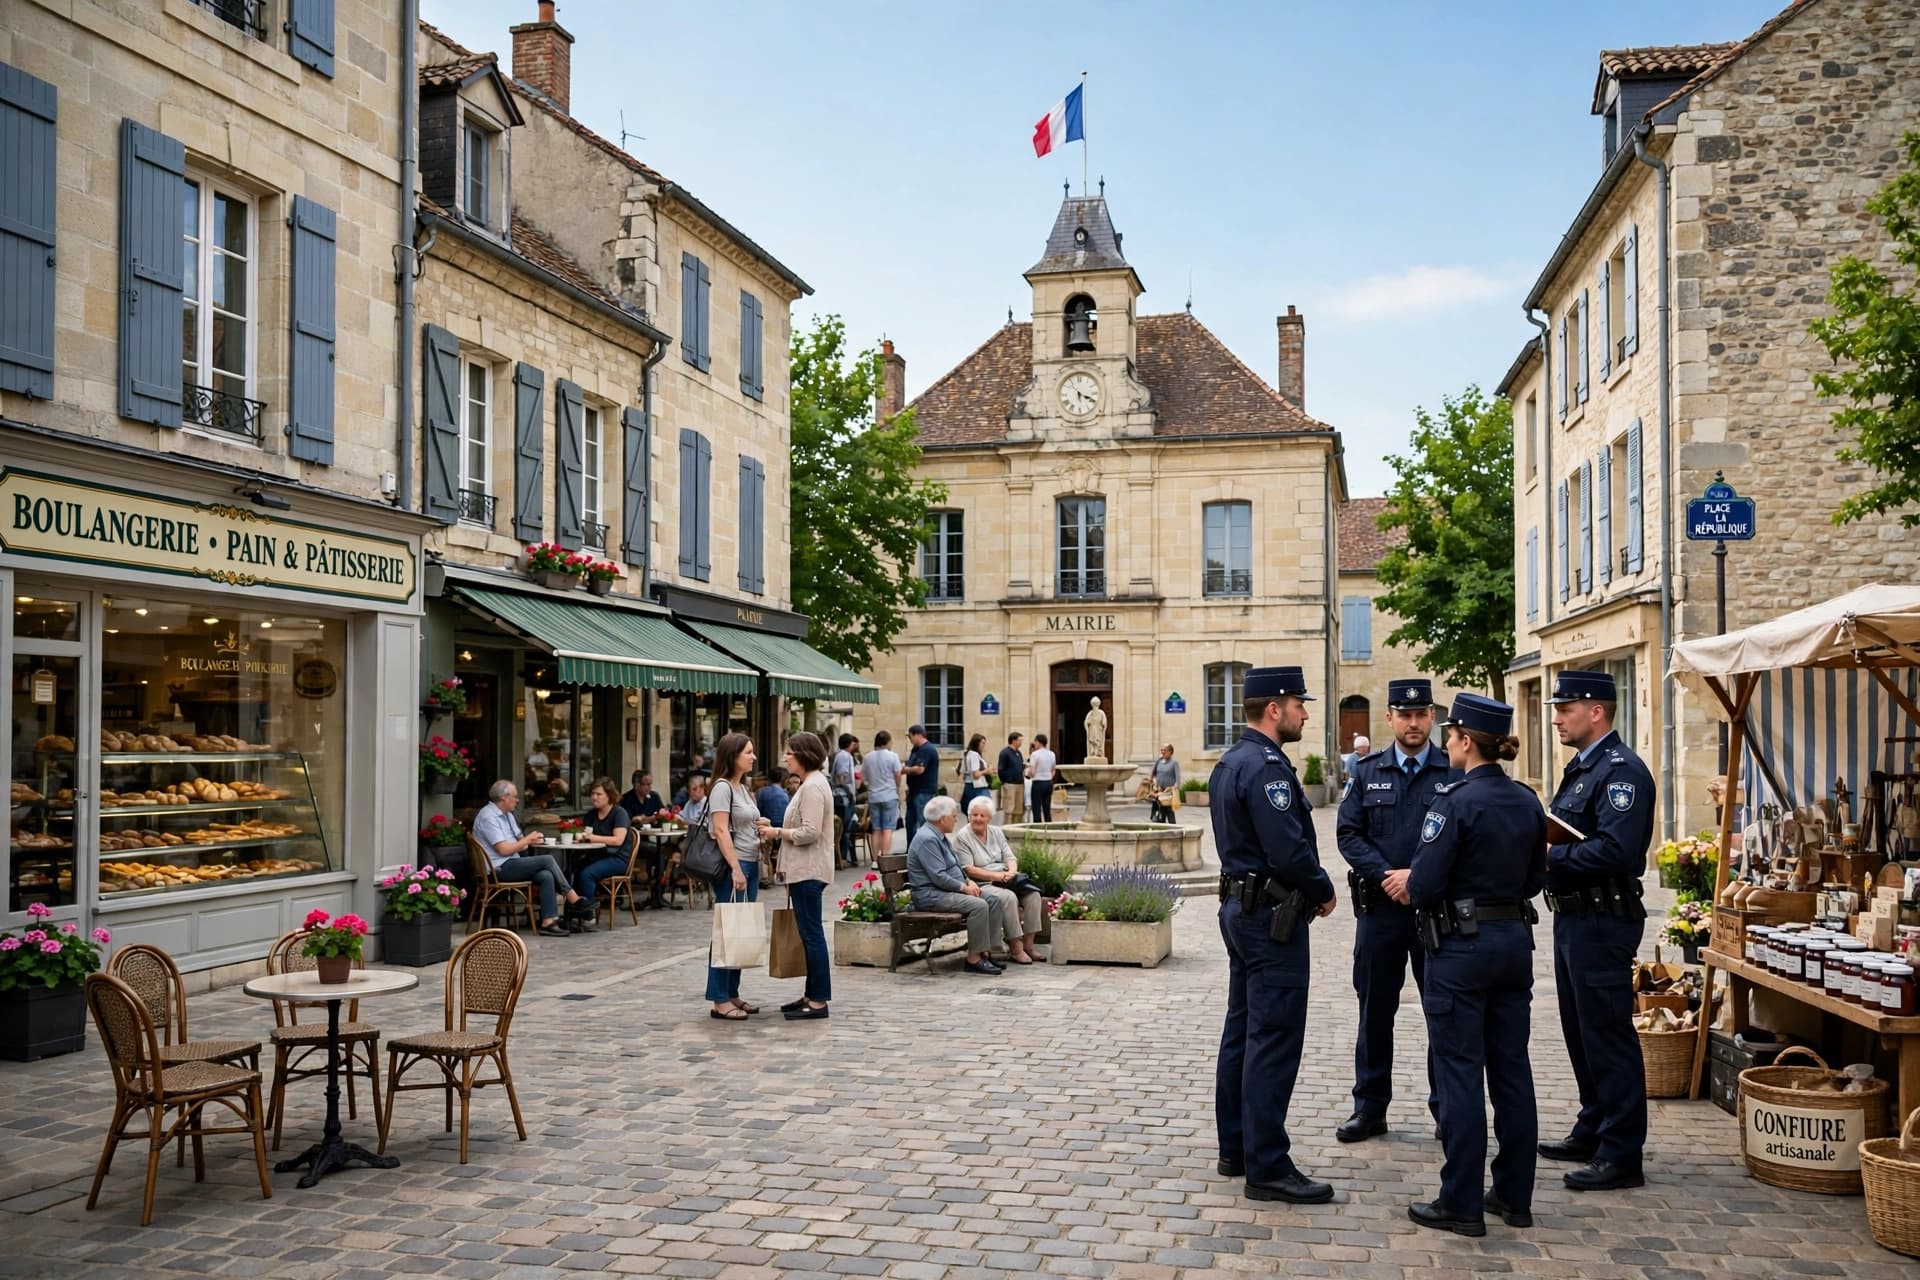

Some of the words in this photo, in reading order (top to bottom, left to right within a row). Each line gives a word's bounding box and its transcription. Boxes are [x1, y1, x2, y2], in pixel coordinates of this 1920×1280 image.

[1704, 503, 1731, 513] PLACE
[1715, 513, 1727, 523] LA
[1695, 521, 1748, 536] RÉPUBLIQUE
[13, 493, 199, 555] BOULANGERIE
[227, 529, 276, 567] PAIN
[284, 540, 298, 570] &
[305, 538, 404, 585] PÂTISSERIE
[1045, 615, 1116, 631] MAIRIE
[1367, 782, 1392, 791] POLICE
[1754, 1108, 1846, 1142] CONFIURE
[1766, 1141, 1836, 1161] artisanale
